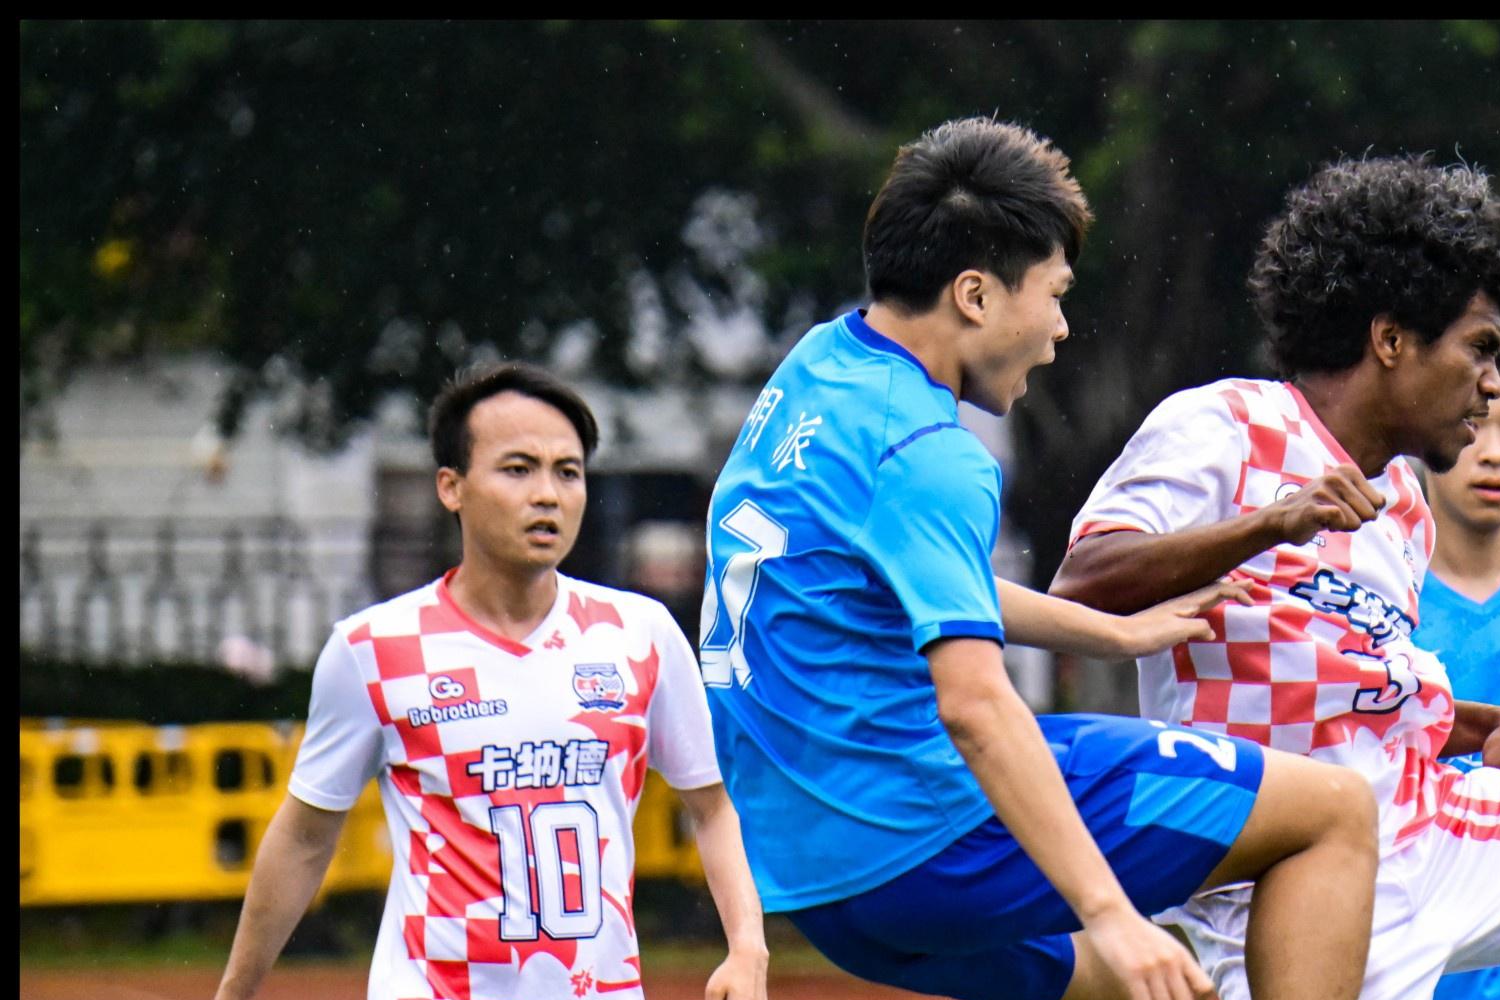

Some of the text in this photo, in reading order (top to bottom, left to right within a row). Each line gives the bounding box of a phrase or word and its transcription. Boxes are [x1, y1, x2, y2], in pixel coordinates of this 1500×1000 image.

[467, 740, 609, 791] 卡纳德
[489, 800, 604, 942] 10
